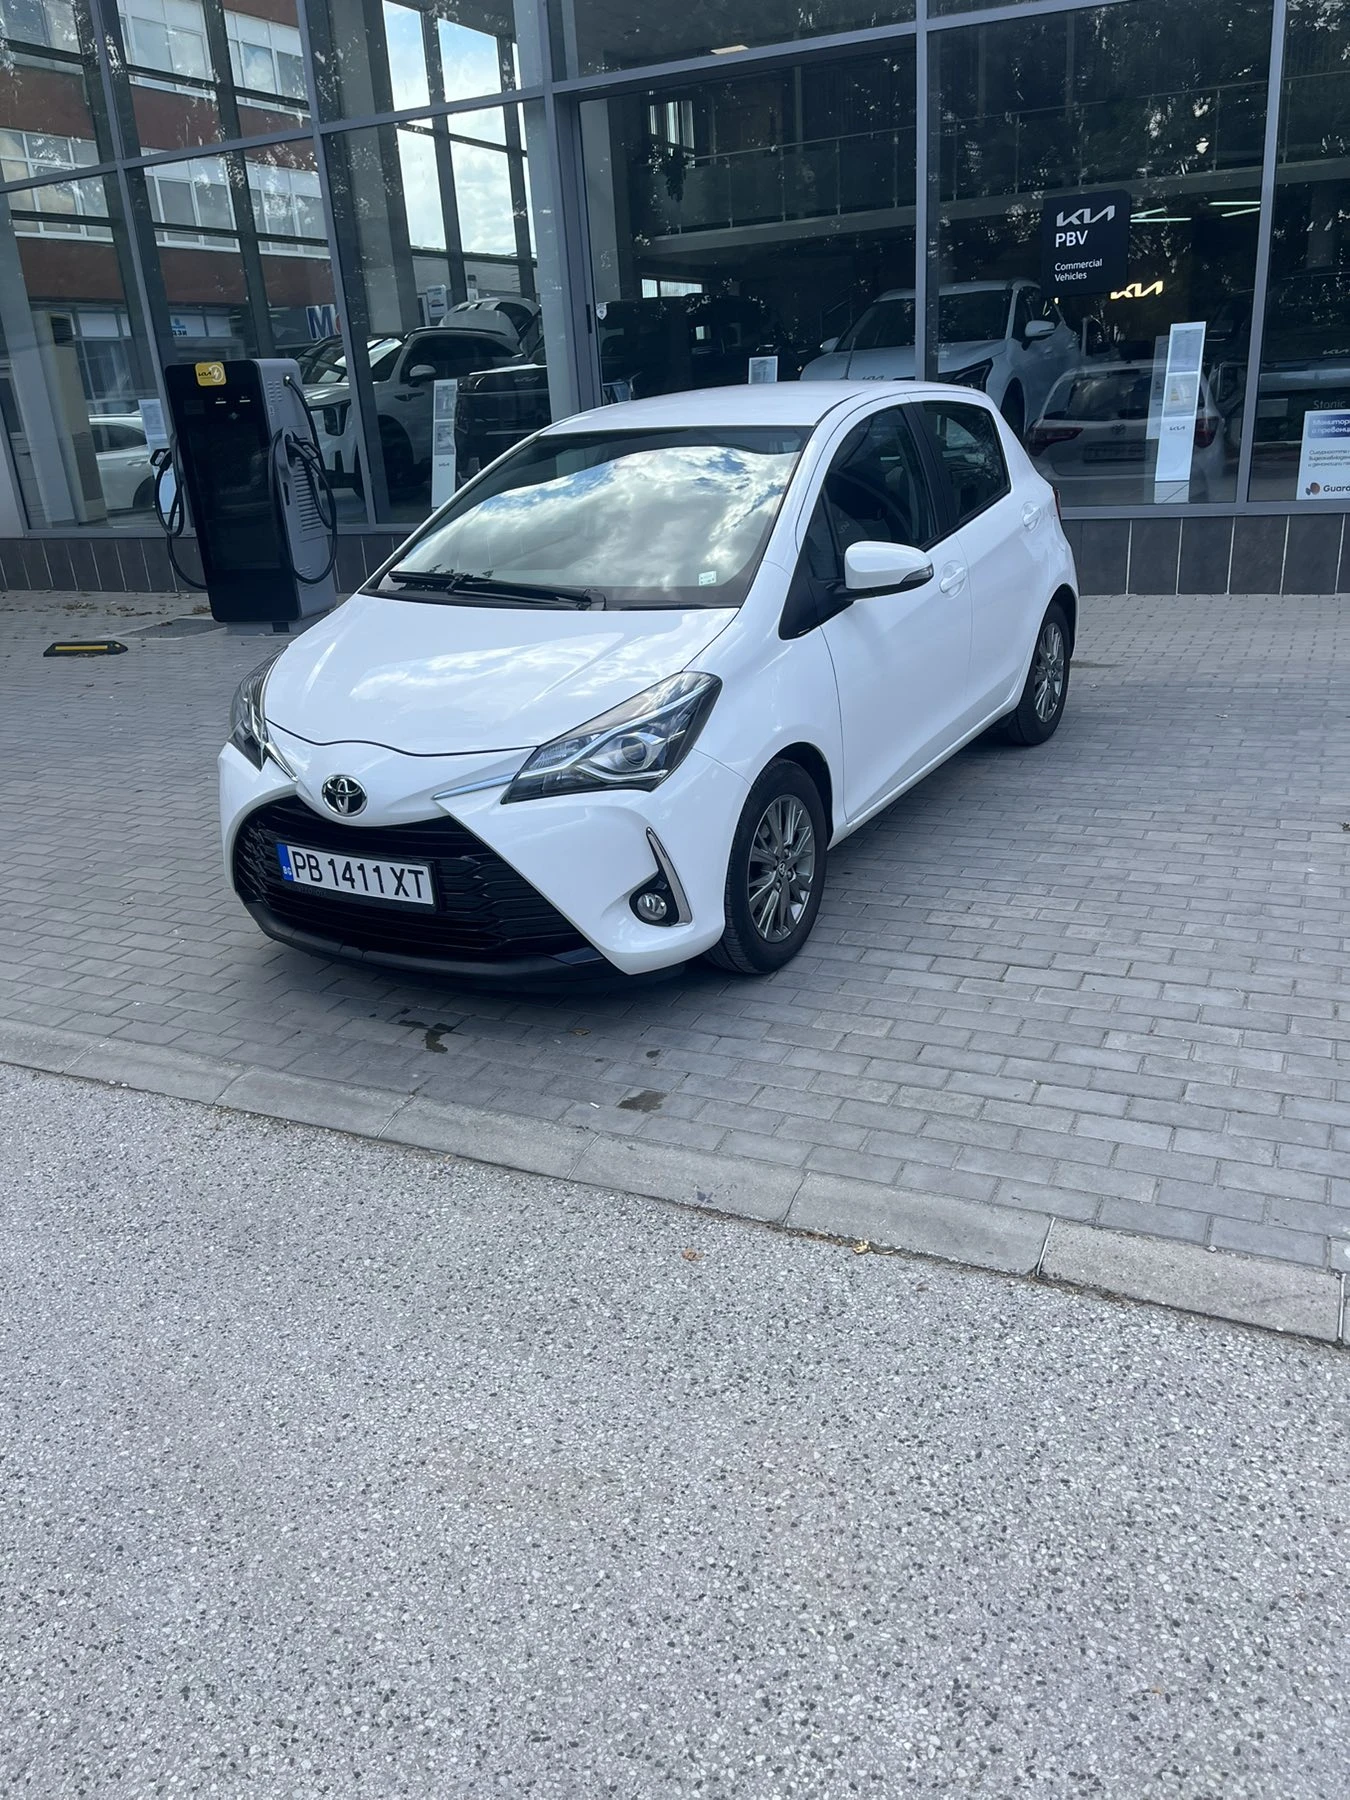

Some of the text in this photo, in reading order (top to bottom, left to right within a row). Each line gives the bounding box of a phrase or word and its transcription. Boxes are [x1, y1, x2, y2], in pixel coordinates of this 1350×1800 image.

[1056, 205, 1116, 227] KIA
[1055, 230, 1089, 248] PBV
[1054, 258, 1103, 271] Commercial
[1054, 271, 1088, 282] Vehicles
[1110, 280, 1164, 300] KIA
[1313, 400, 1347, 410] Stonic
[328, 858, 385, 894] 1411
